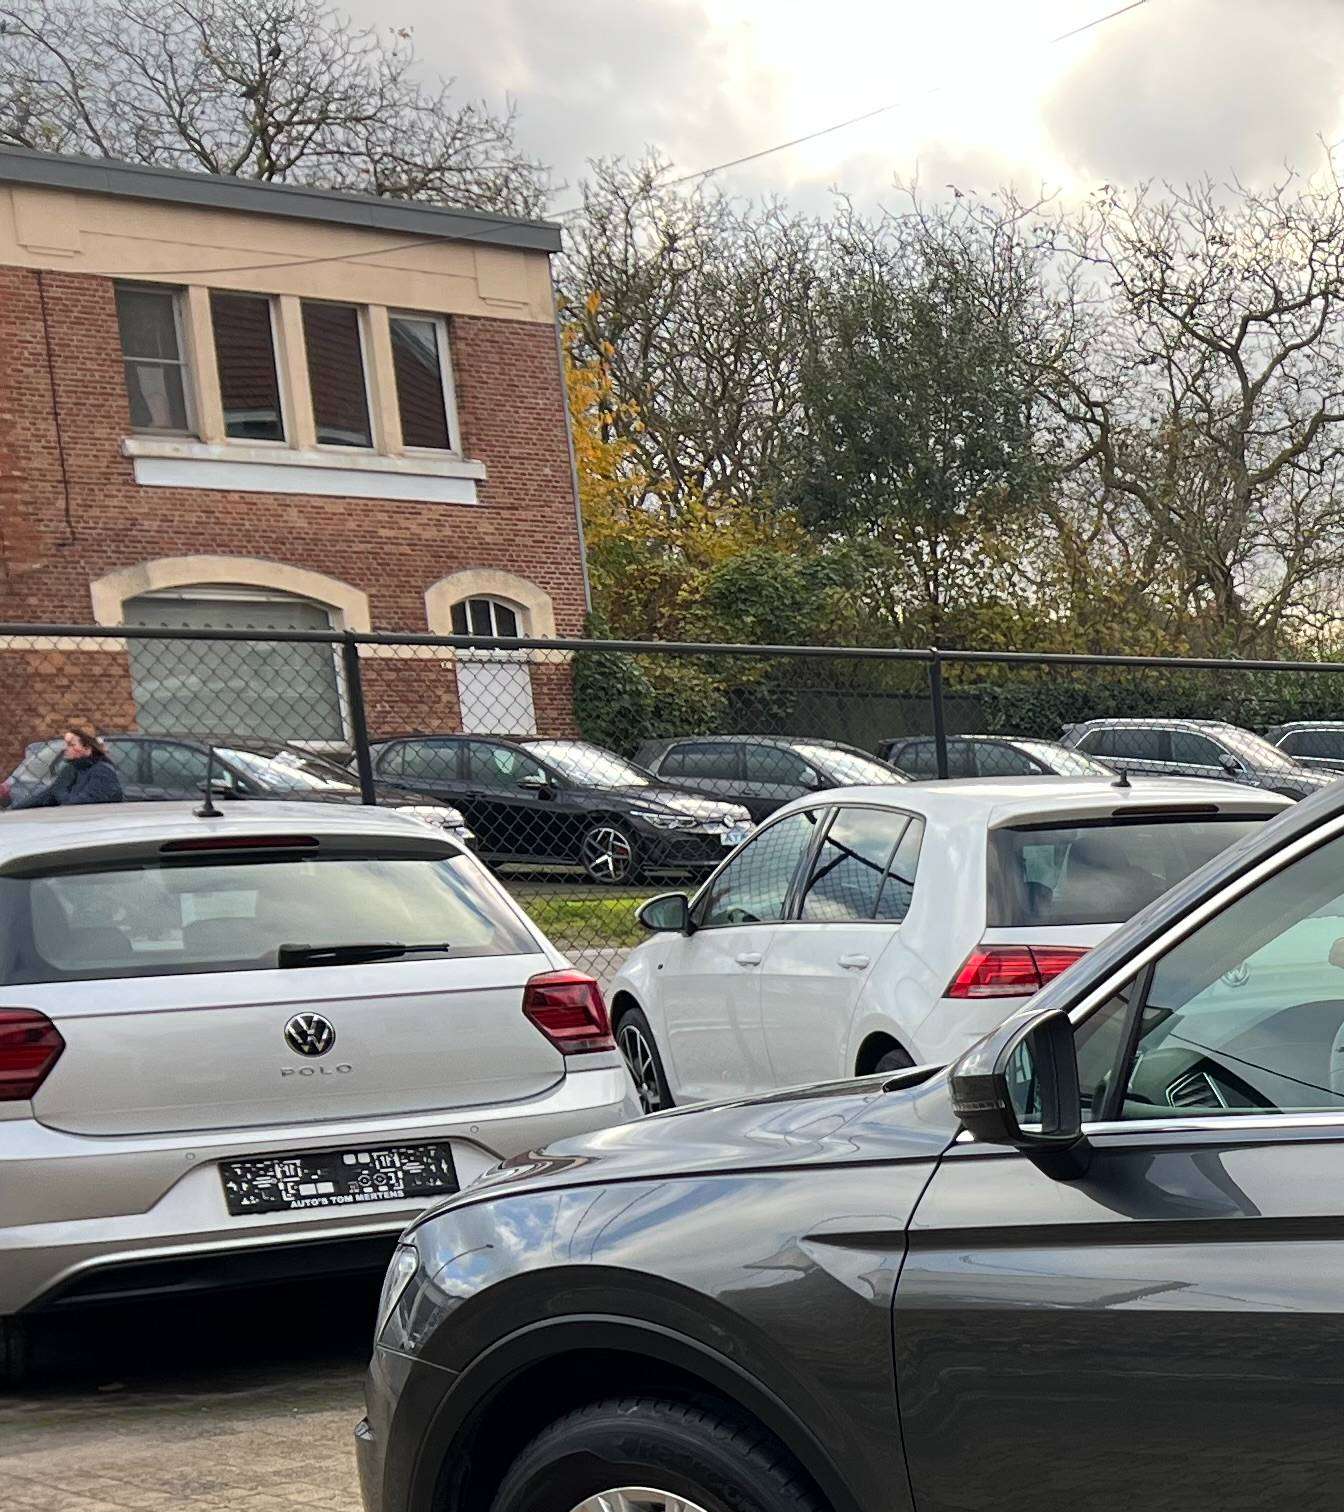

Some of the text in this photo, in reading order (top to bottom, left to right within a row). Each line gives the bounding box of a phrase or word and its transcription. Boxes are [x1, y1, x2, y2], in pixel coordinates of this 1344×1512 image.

[281, 1063, 353, 1078] POLO
[290, 1190, 405, 1209] AUTO'S TOM MERTENS
